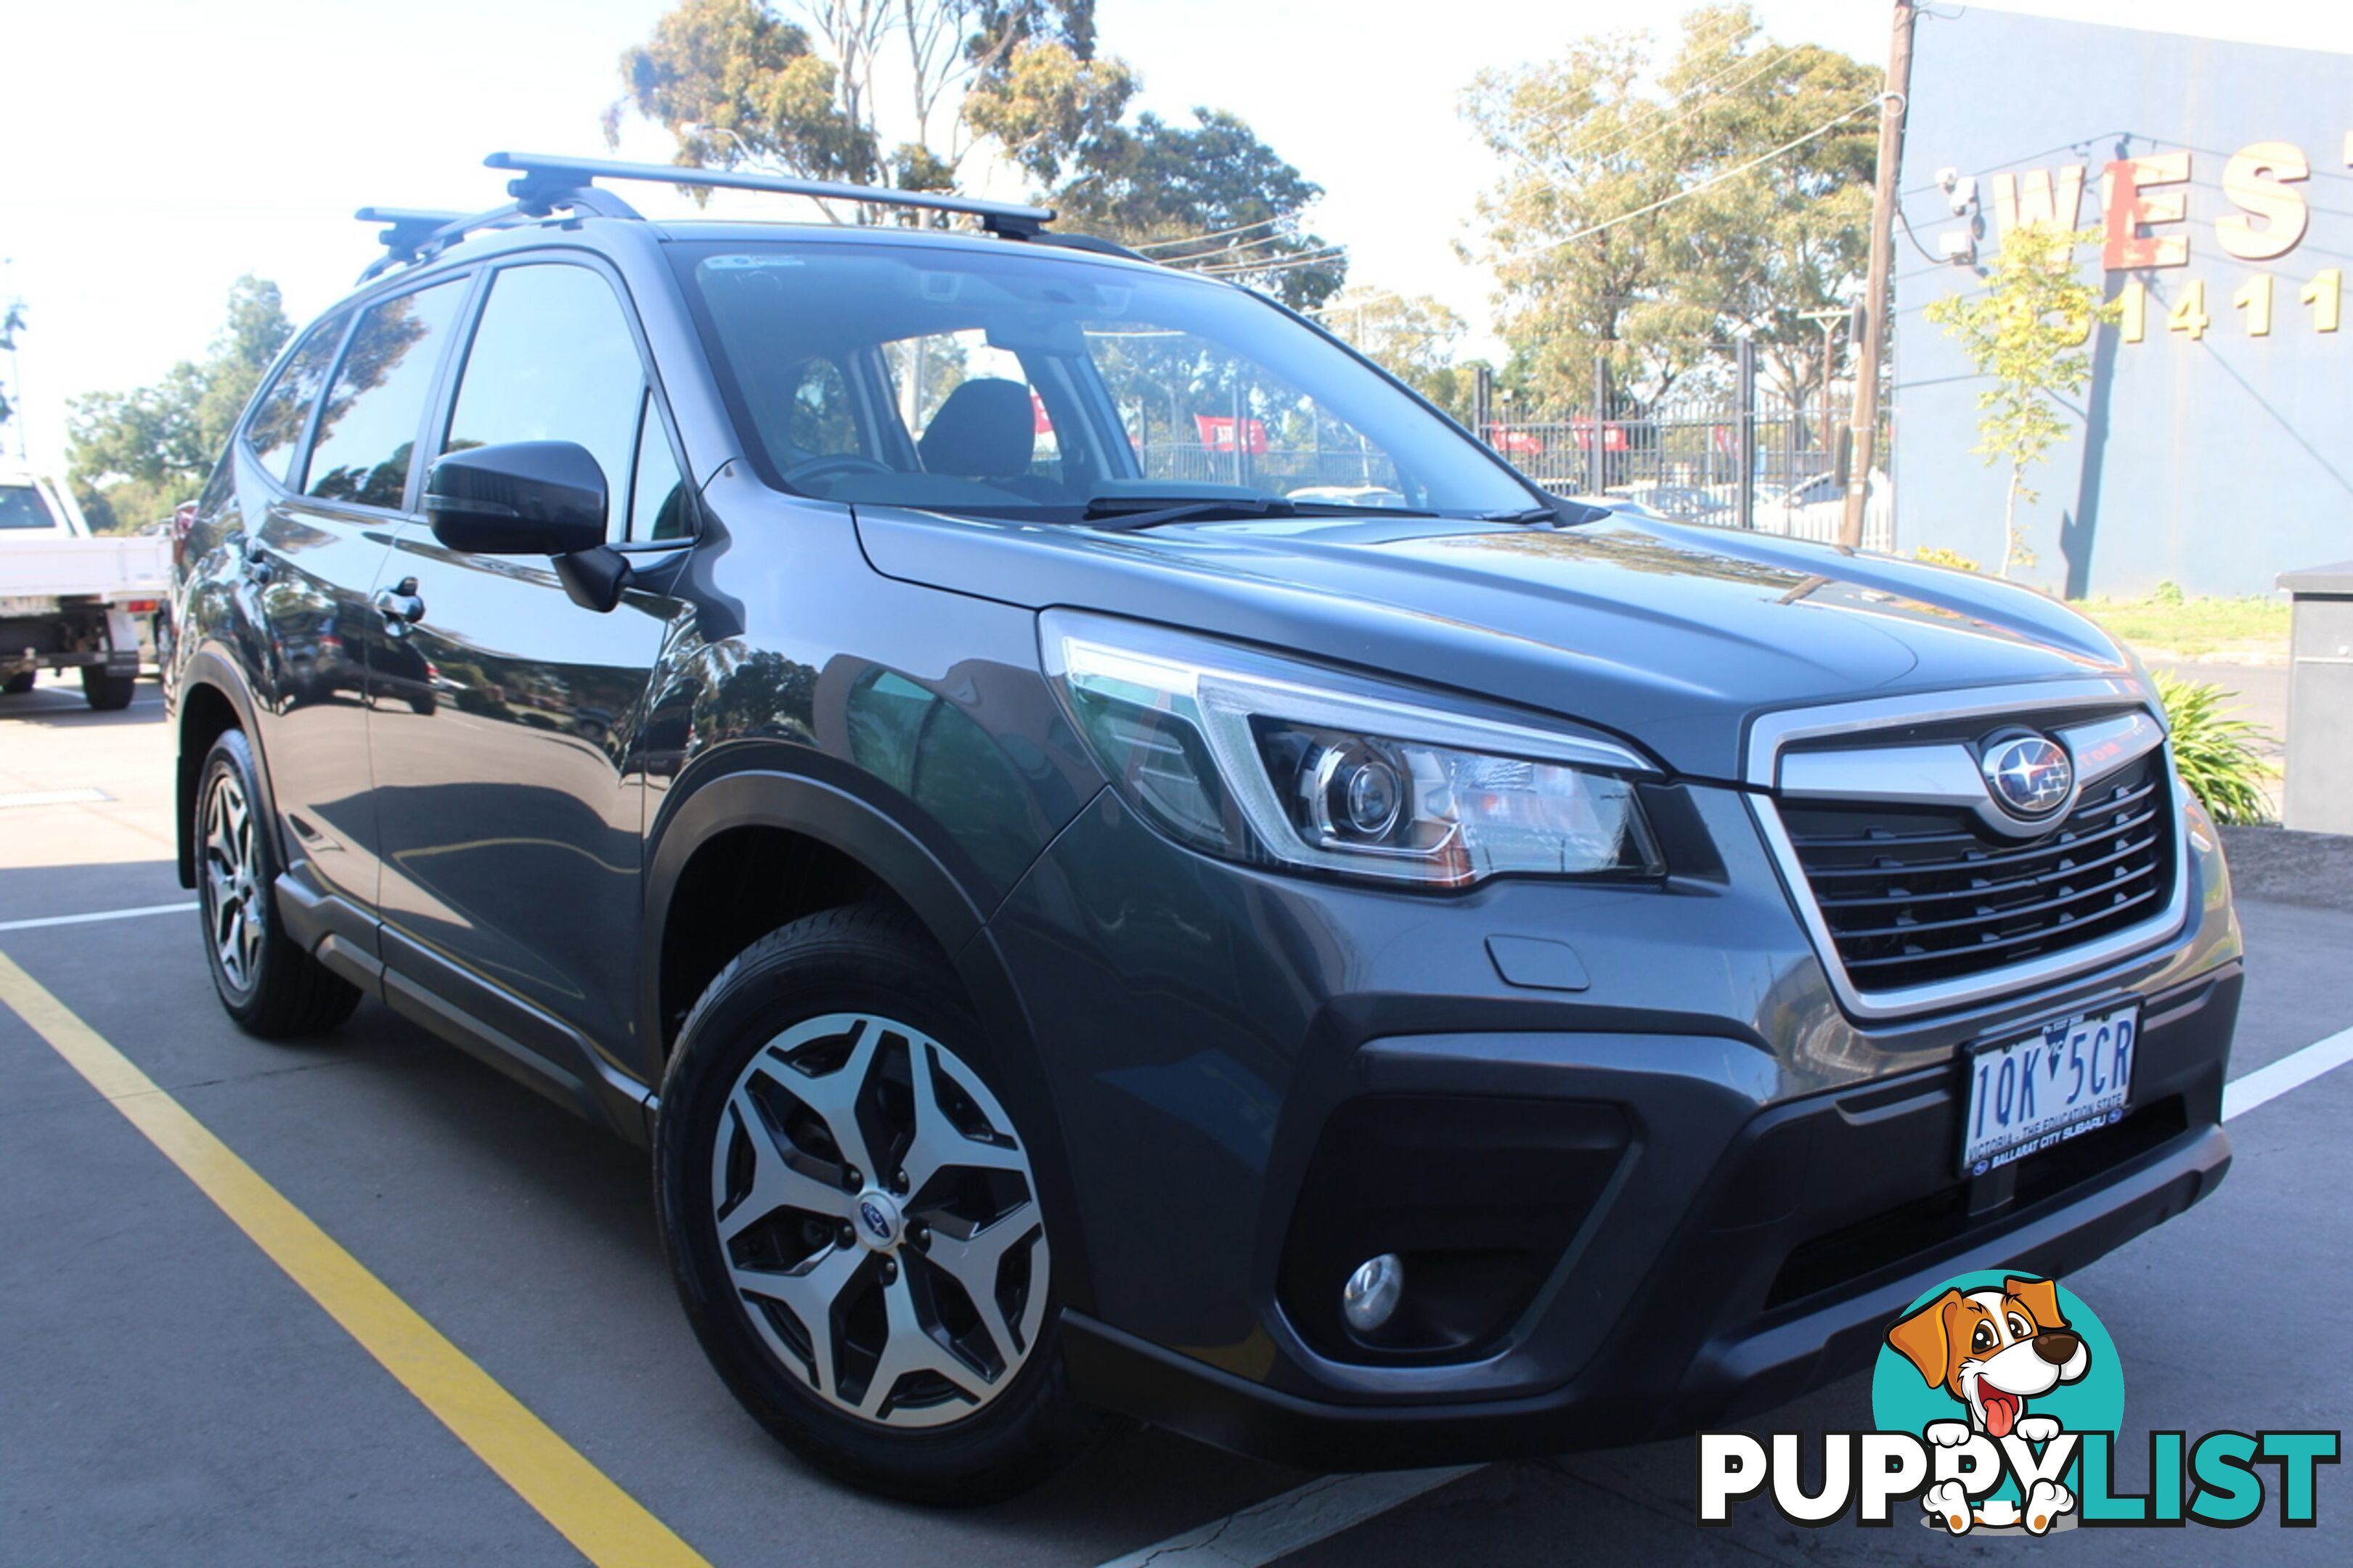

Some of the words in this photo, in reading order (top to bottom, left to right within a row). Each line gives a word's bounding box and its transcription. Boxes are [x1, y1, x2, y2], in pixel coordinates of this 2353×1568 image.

[1992, 129, 2353, 274] WES
[1975, 1048, 2041, 1140] 1QK
[2065, 1019, 2132, 1105] 5CR
[1968, 1132, 2013, 1164] VICTORIA
[2023, 1122, 2040, 1137] THE
[2043, 1102, 2094, 1132] EDUCATION
[2096, 1093, 2123, 1113] STATE
[1991, 1139, 2039, 1169] BALLARAT
[2039, 1130, 2062, 1148] CITY
[2062, 1113, 2107, 1141] SUBARU
